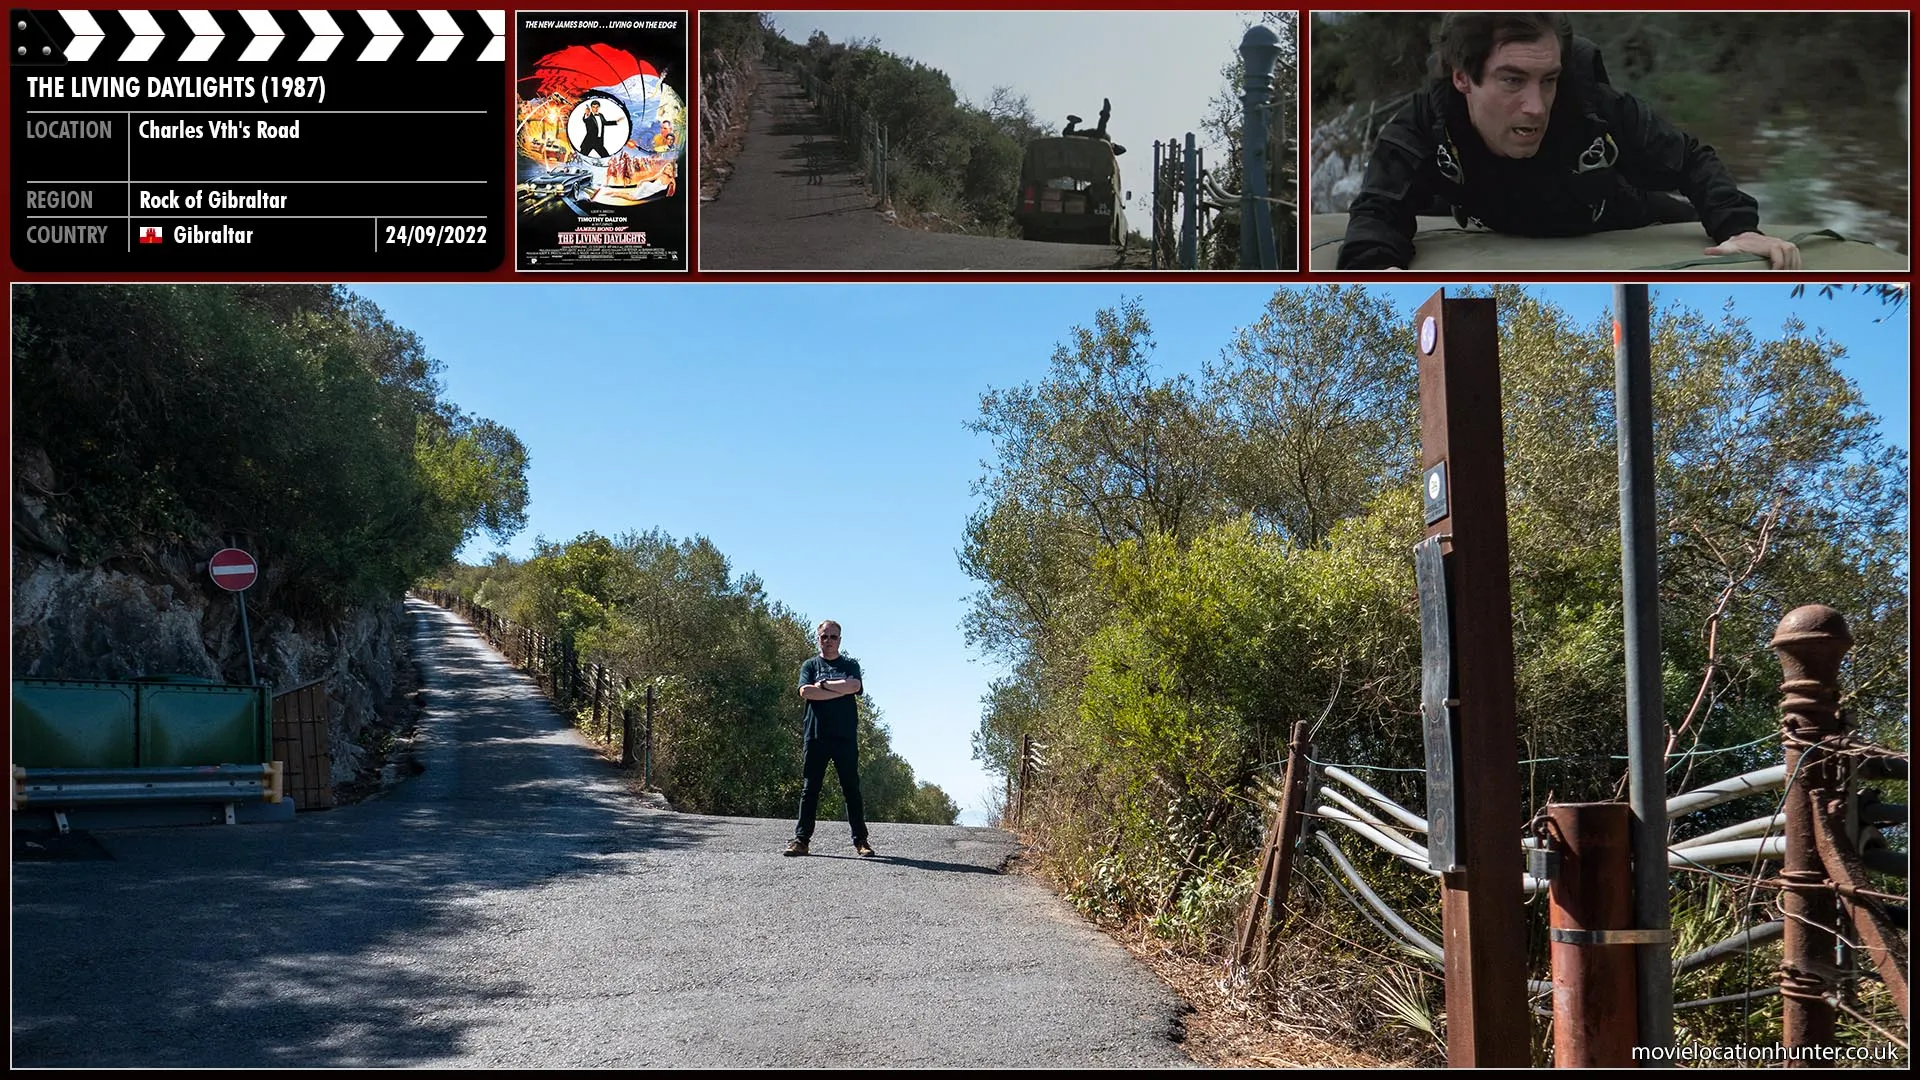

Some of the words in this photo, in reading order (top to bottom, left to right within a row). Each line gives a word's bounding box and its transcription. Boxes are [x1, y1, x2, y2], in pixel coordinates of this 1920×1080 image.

[525, 21, 538, 29] THE
[538, 21, 555, 29] NEW
[555, 21, 578, 29] JAMES
[609, 21, 633, 29] LIVING
[633, 21, 645, 29] ON
[645, 21, 658, 29] THE
[658, 21, 678, 29] EDGE
[558, 232, 574, 245] THE
[575, 232, 603, 245] LIVING
[603, 232, 647, 245] DAYLIGHTS
